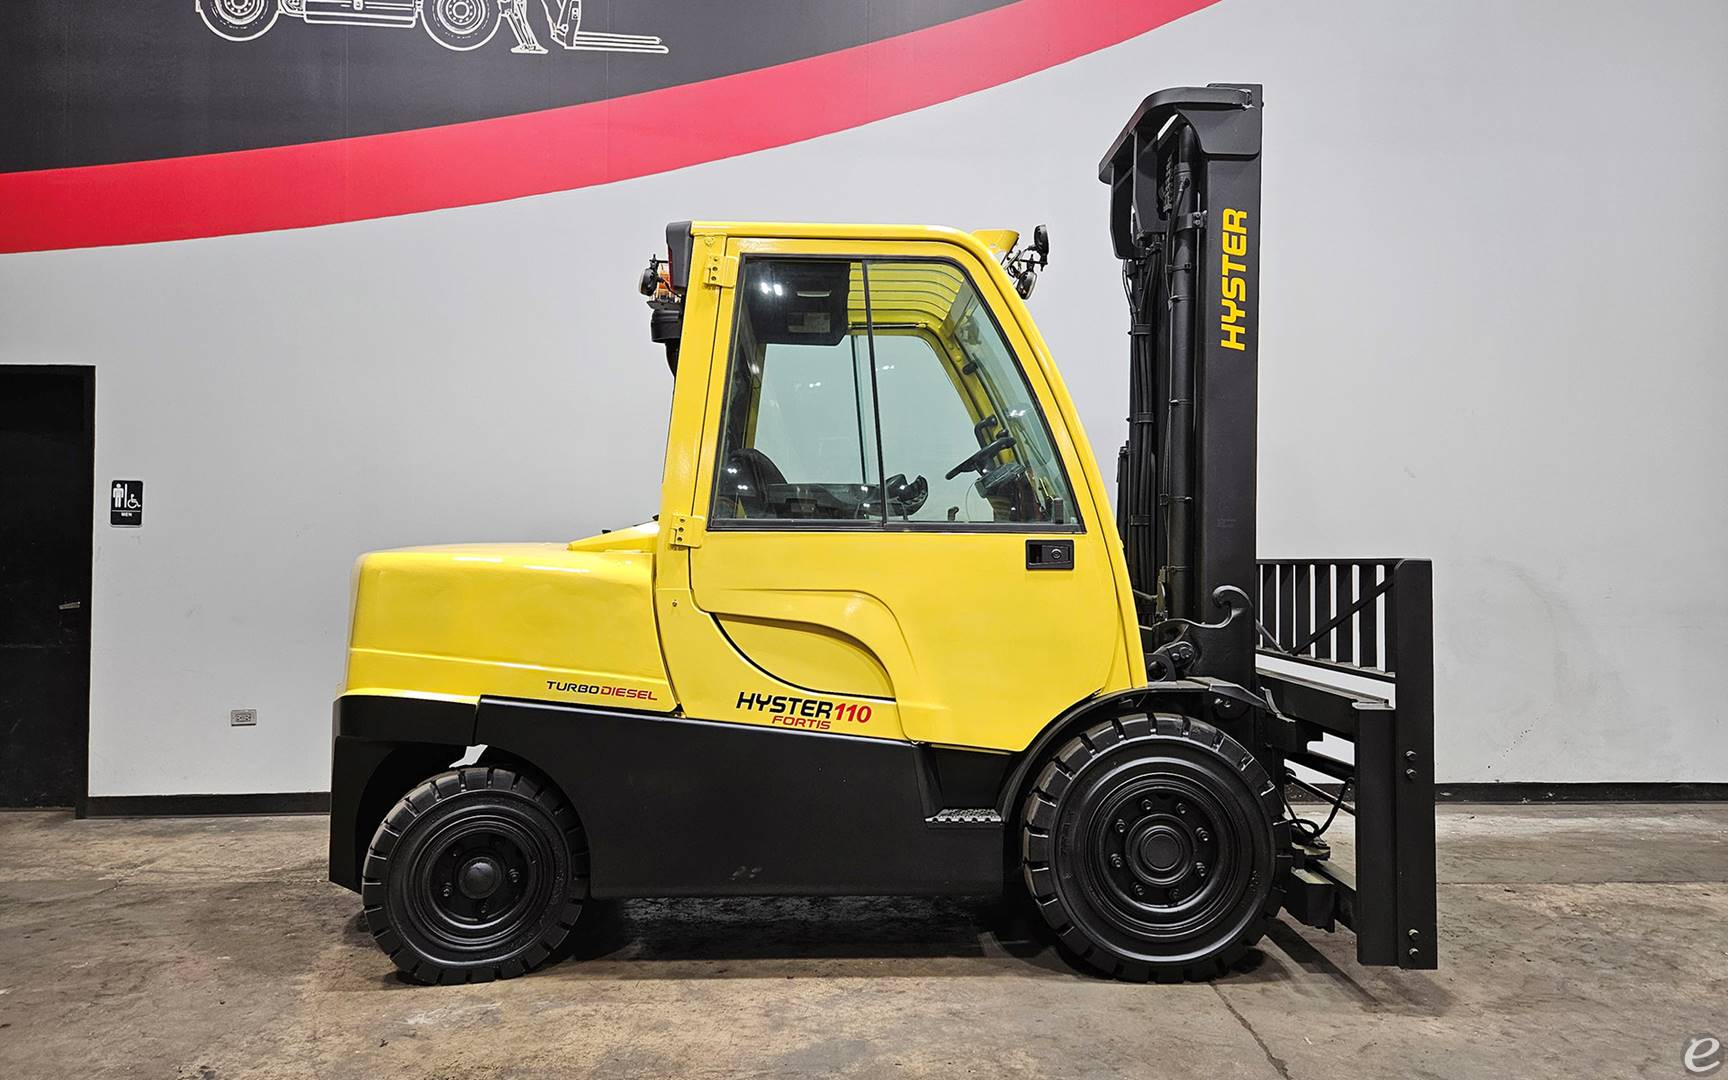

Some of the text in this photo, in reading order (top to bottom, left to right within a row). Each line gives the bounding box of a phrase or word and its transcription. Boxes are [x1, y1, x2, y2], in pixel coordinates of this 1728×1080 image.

[1220, 208, 1247, 351] HYSTER
[736, 692, 872, 723] HYSTER 110
[771, 715, 831, 730] FORTIS
